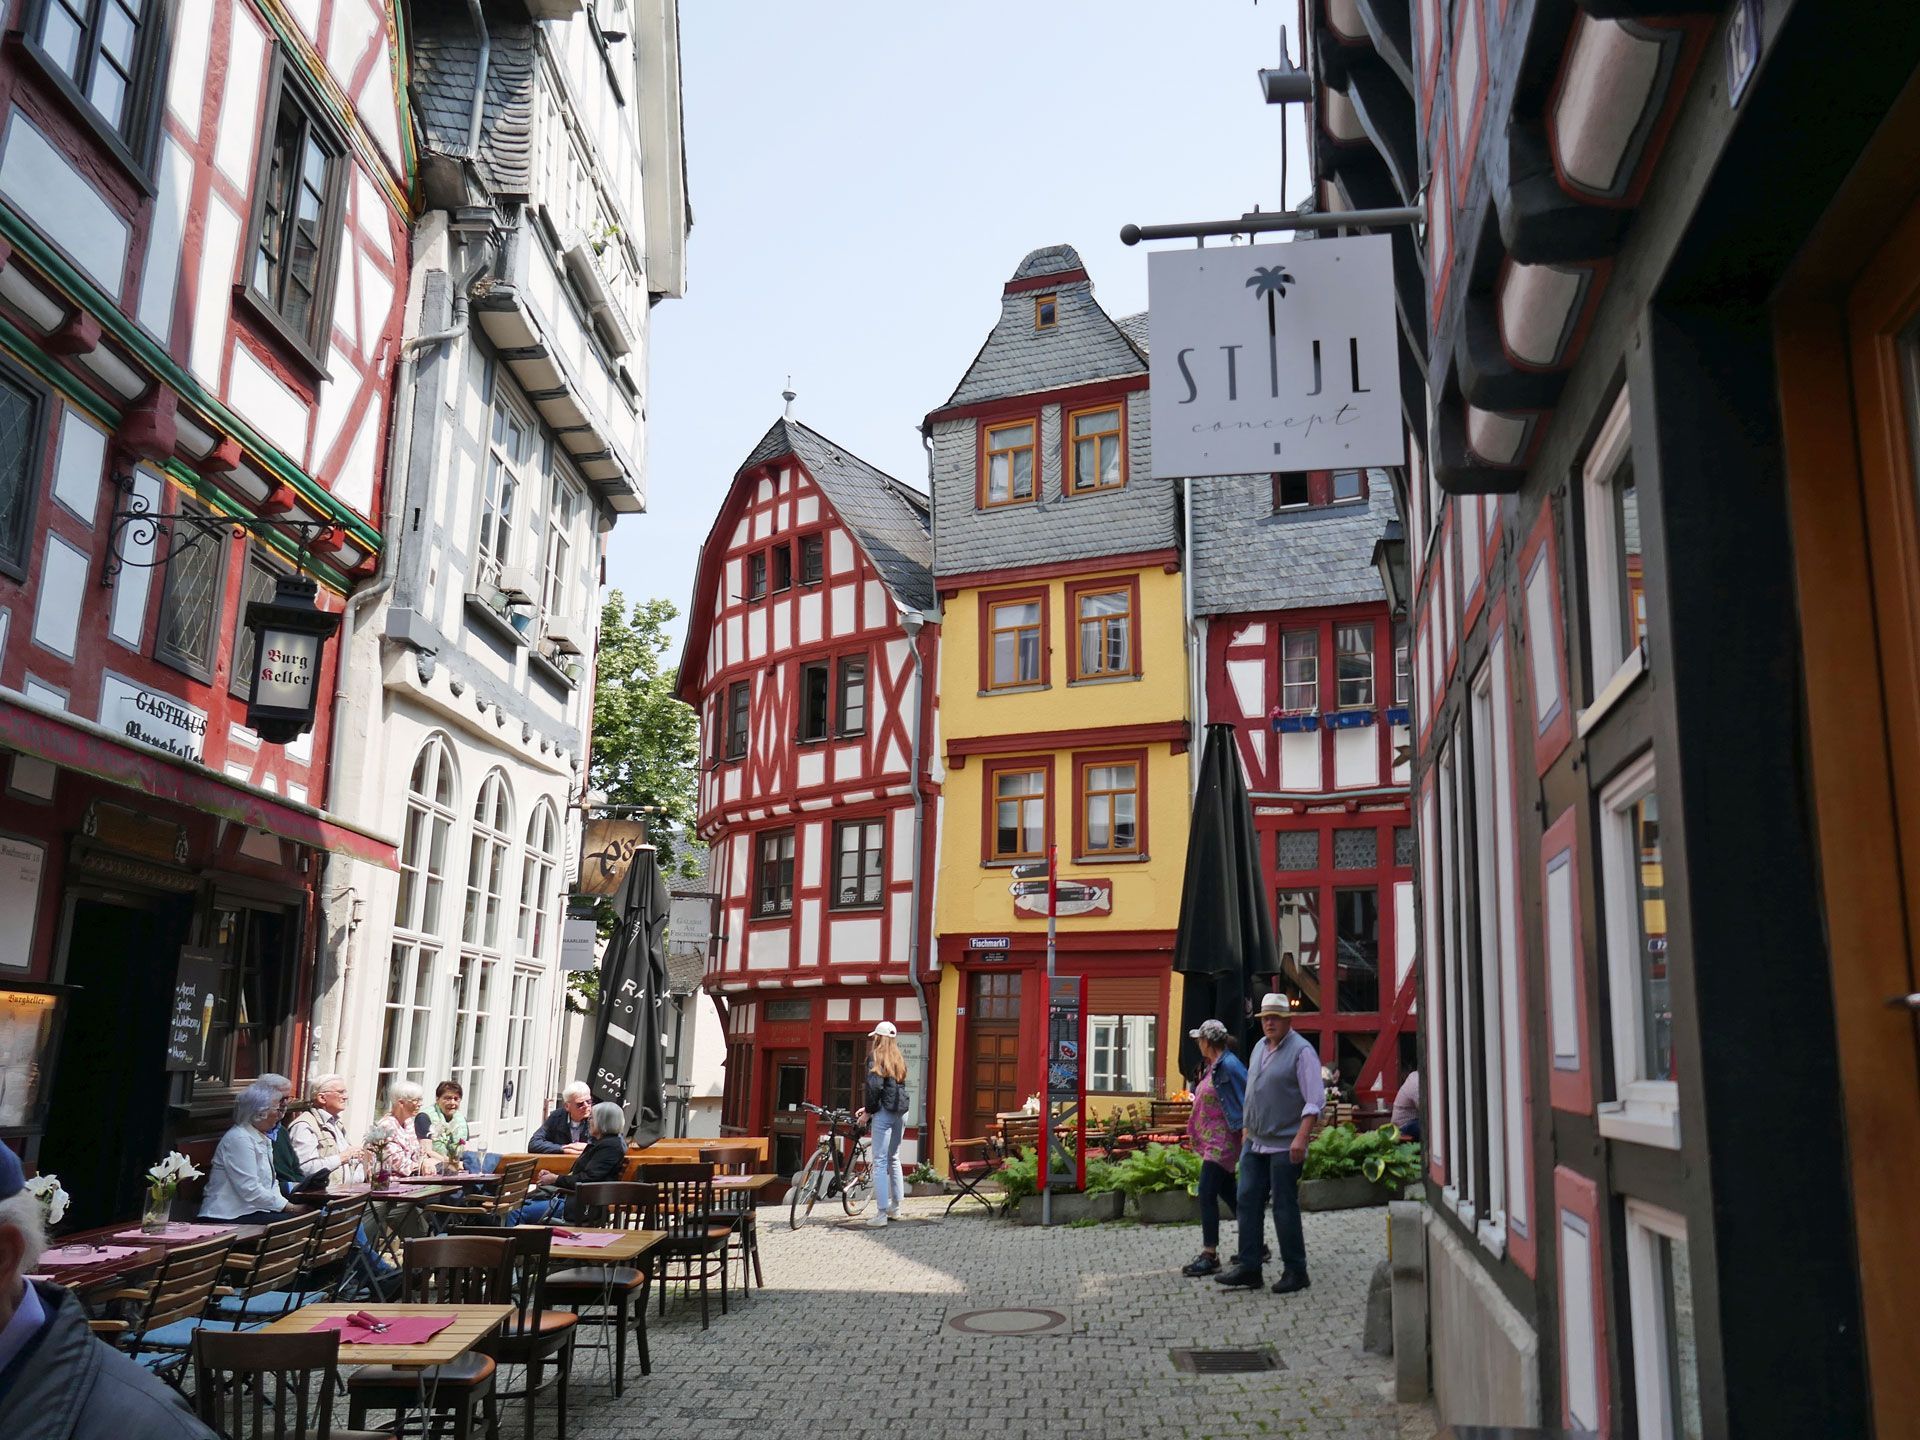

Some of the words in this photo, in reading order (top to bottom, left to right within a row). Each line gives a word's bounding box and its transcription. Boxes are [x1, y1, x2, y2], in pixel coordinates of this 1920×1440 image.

[1177, 290, 1371, 405] STIJL
[1192, 404, 1361, 438] concept
[267, 649, 308, 669] Burg
[261, 667, 310, 685] Keller
[136, 691, 208, 736] GASTHAUS
[972, 939, 1006, 948] Fischmarkt
[8, 994, 46, 1005] Burgkeller
